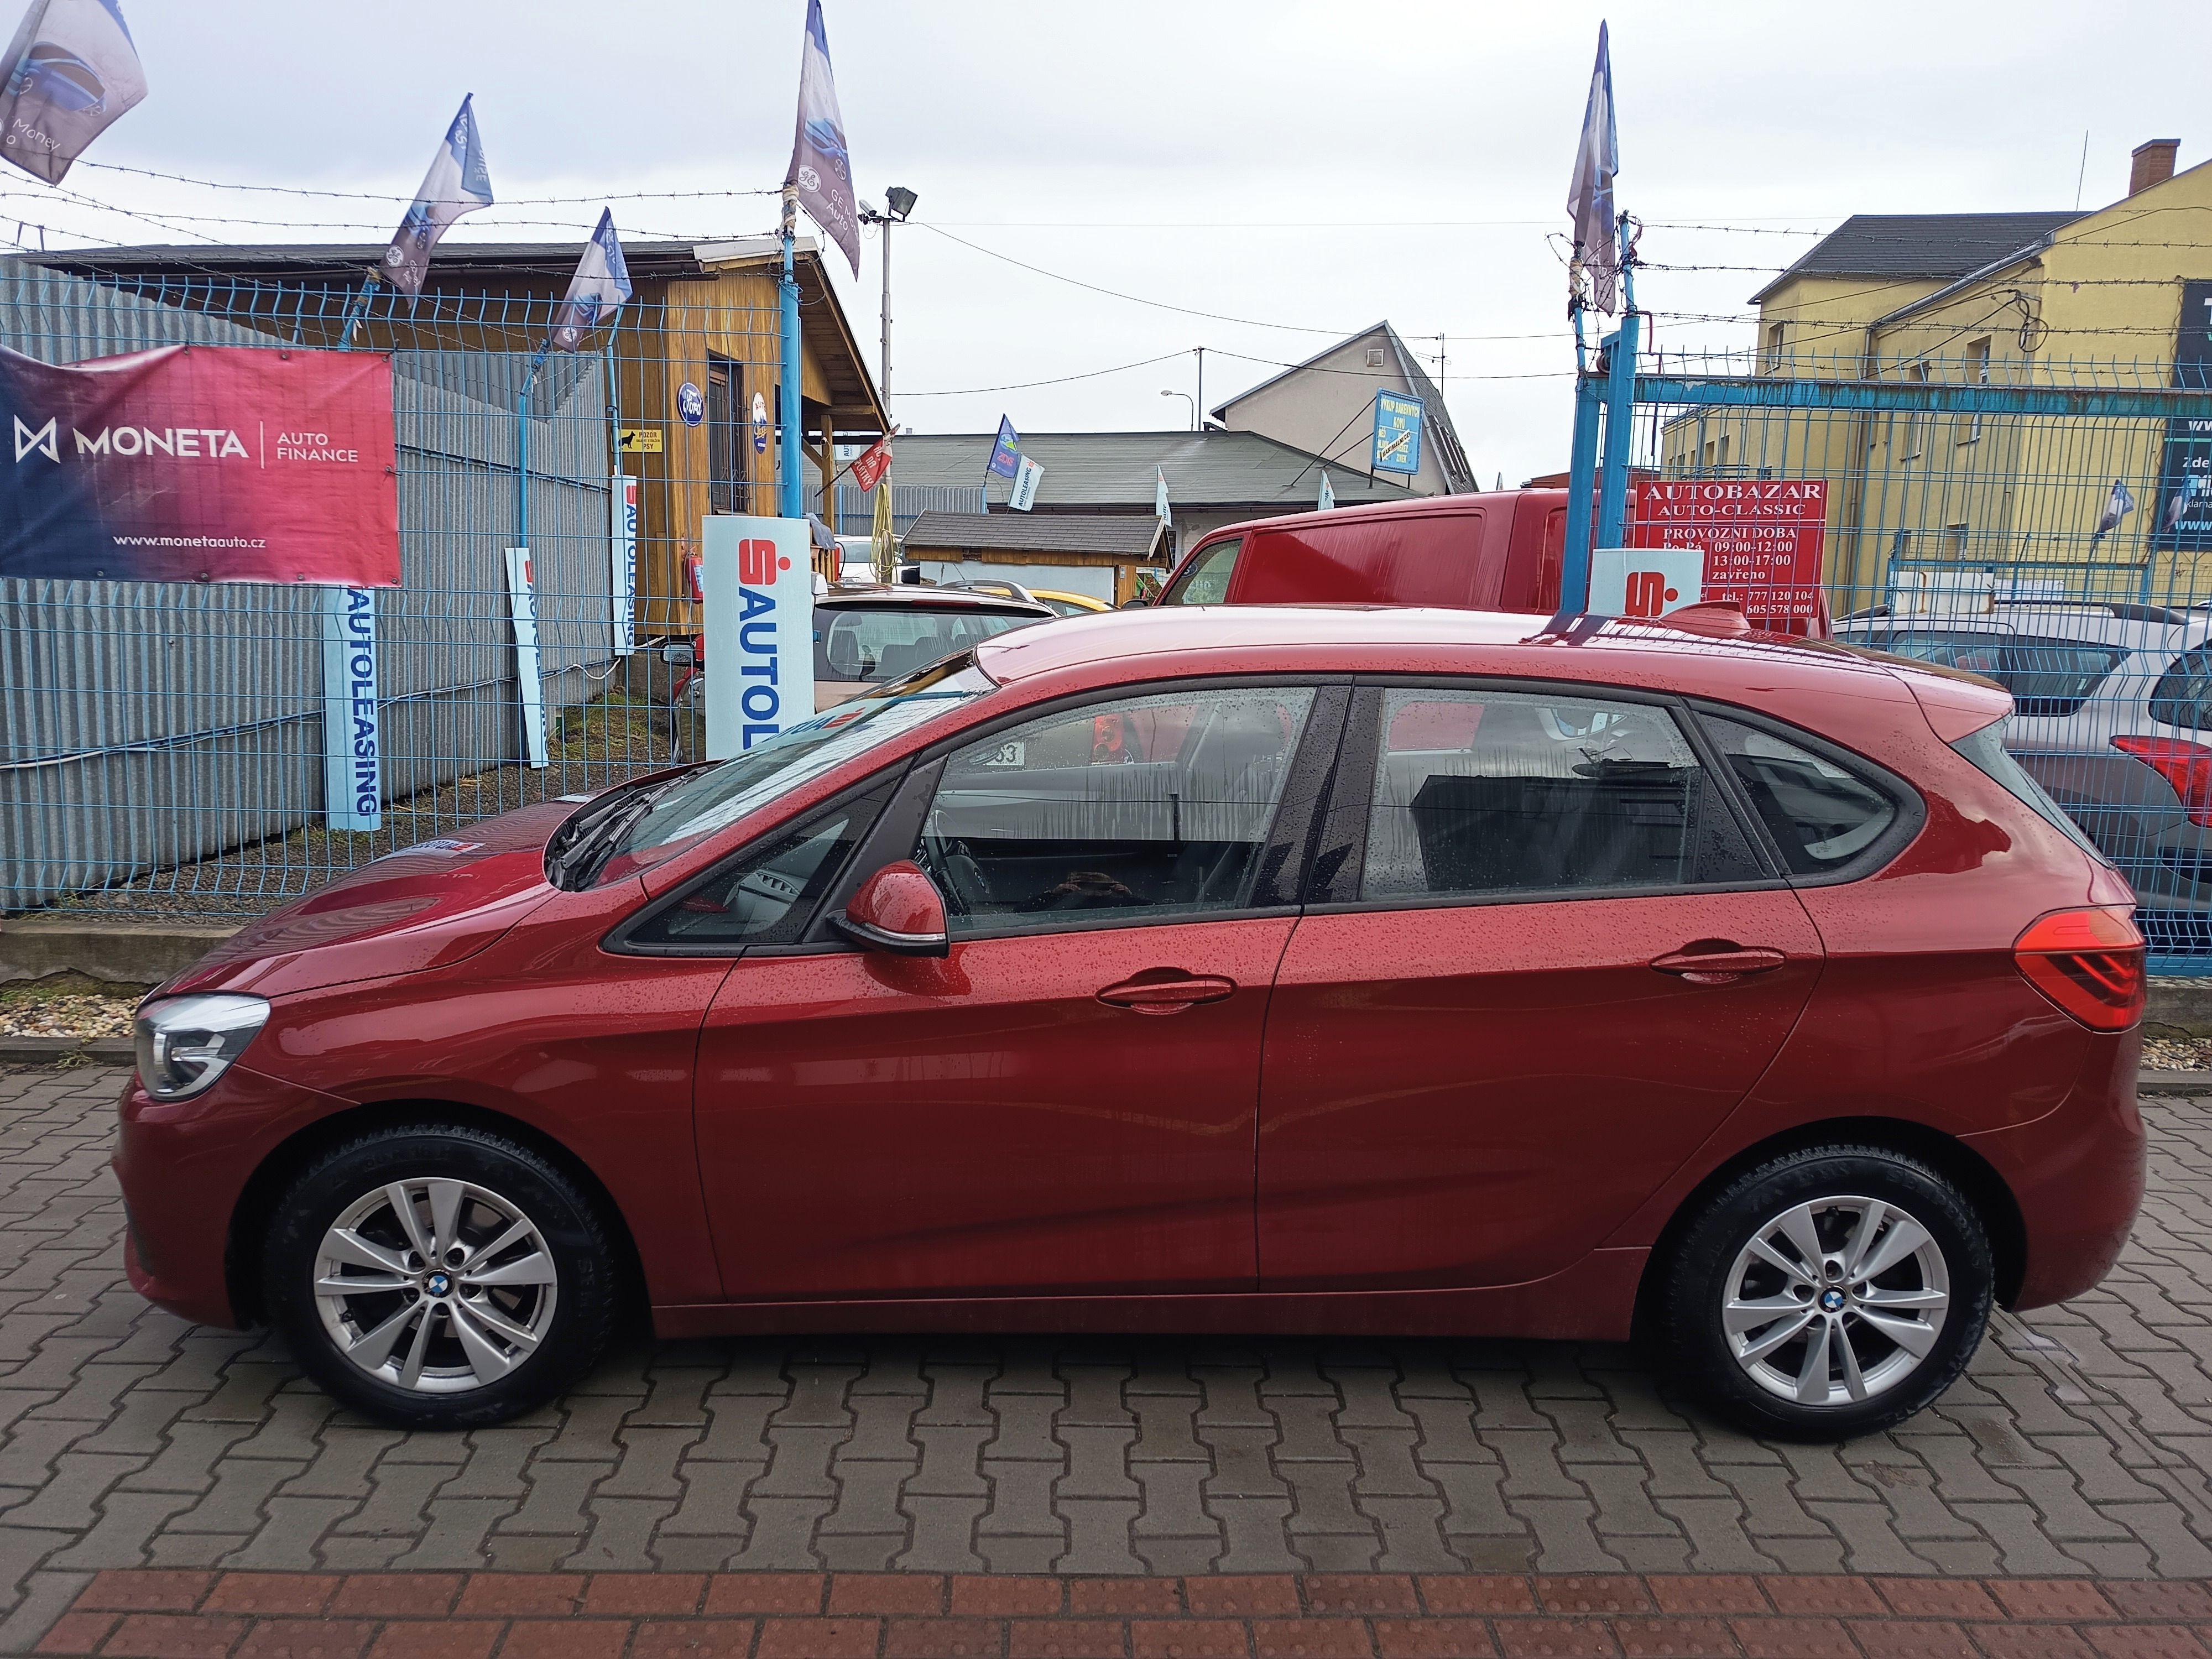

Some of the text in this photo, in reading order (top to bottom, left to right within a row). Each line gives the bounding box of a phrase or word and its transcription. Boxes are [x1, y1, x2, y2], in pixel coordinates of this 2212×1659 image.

[12, 118, 61, 152] Money
[826, 202, 848, 231] Auto
[831, 189, 860, 246] GE Mone
[682, 389, 702, 416] Ford
[72, 426, 329, 458] MONETA AUTO
[278, 447, 359, 463] FINANCE
[1018, 467, 1032, 507] AUTOLEASING
[1644, 484, 1822, 500] AUTOBAZAR
[1657, 504, 1806, 517] AUTO-CLASSIC
[1663, 525, 1797, 540] PROVOZNÍ DOBA
[113, 535, 266, 549] www.monetaauto.cz
[1712, 568, 1766, 580] zavřeno
[1721, 591, 1814, 601] tel.: 777 120 104
[1747, 604, 1813, 614] 605 578 000
[346, 589, 377, 817] AUTOLEASING
